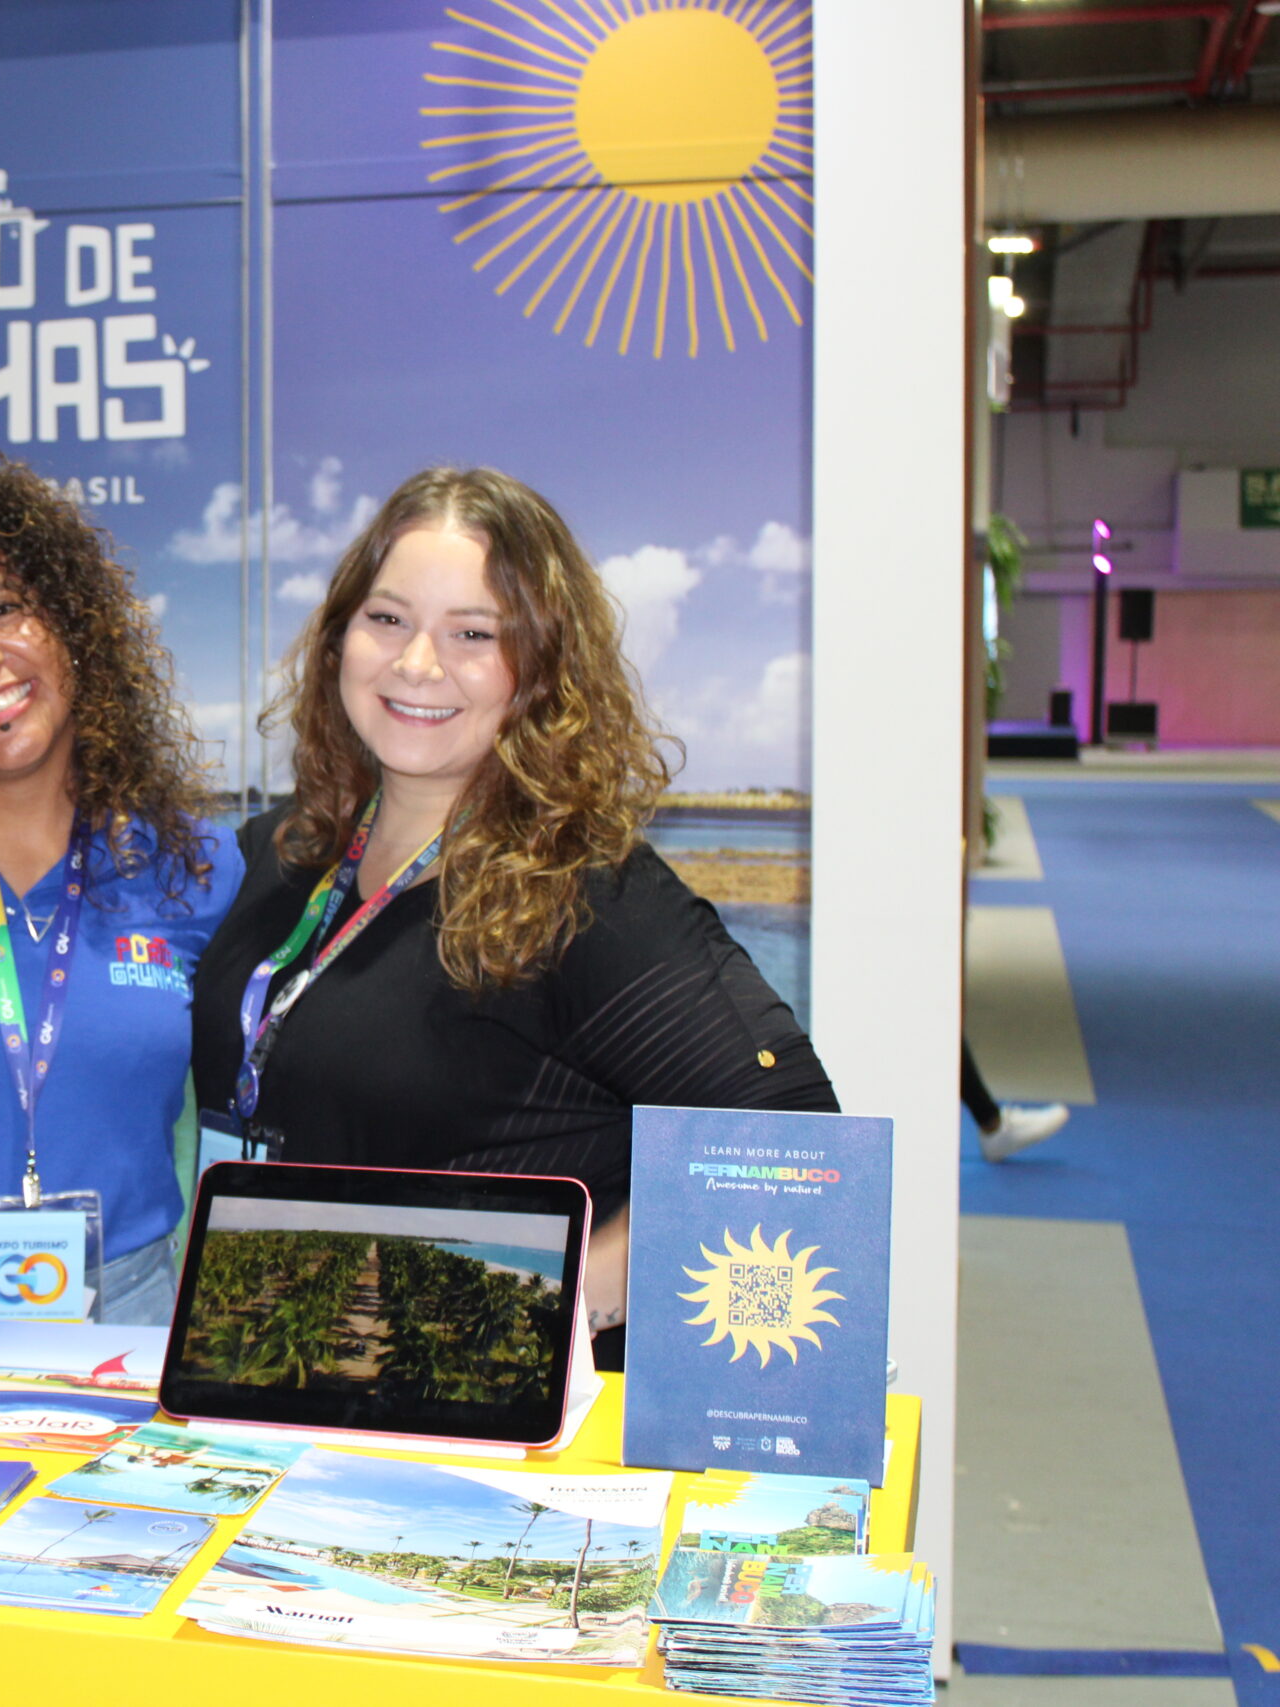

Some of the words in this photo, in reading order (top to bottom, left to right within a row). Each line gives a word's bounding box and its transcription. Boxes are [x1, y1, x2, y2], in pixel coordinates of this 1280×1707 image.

[65, 223, 156, 308] DE
[704, 1145, 741, 1157] LEARN
[746, 1148, 780, 1159] MORE
[785, 1150, 826, 1161] ABOUT
[688, 1162, 841, 1184] PERNAMBUCO
[706, 1176, 760, 1191] Awesome
[764, 1182, 778, 1196] by
[22, 1240, 70, 1251] TURISMO
[706, 1409, 808, 1425] @DESCUBRAPERNAMBUCO
[699, 1540, 789, 1555] NAM
[731, 1560, 768, 1604] BUCO
[256, 1605, 354, 1624] Marriott
